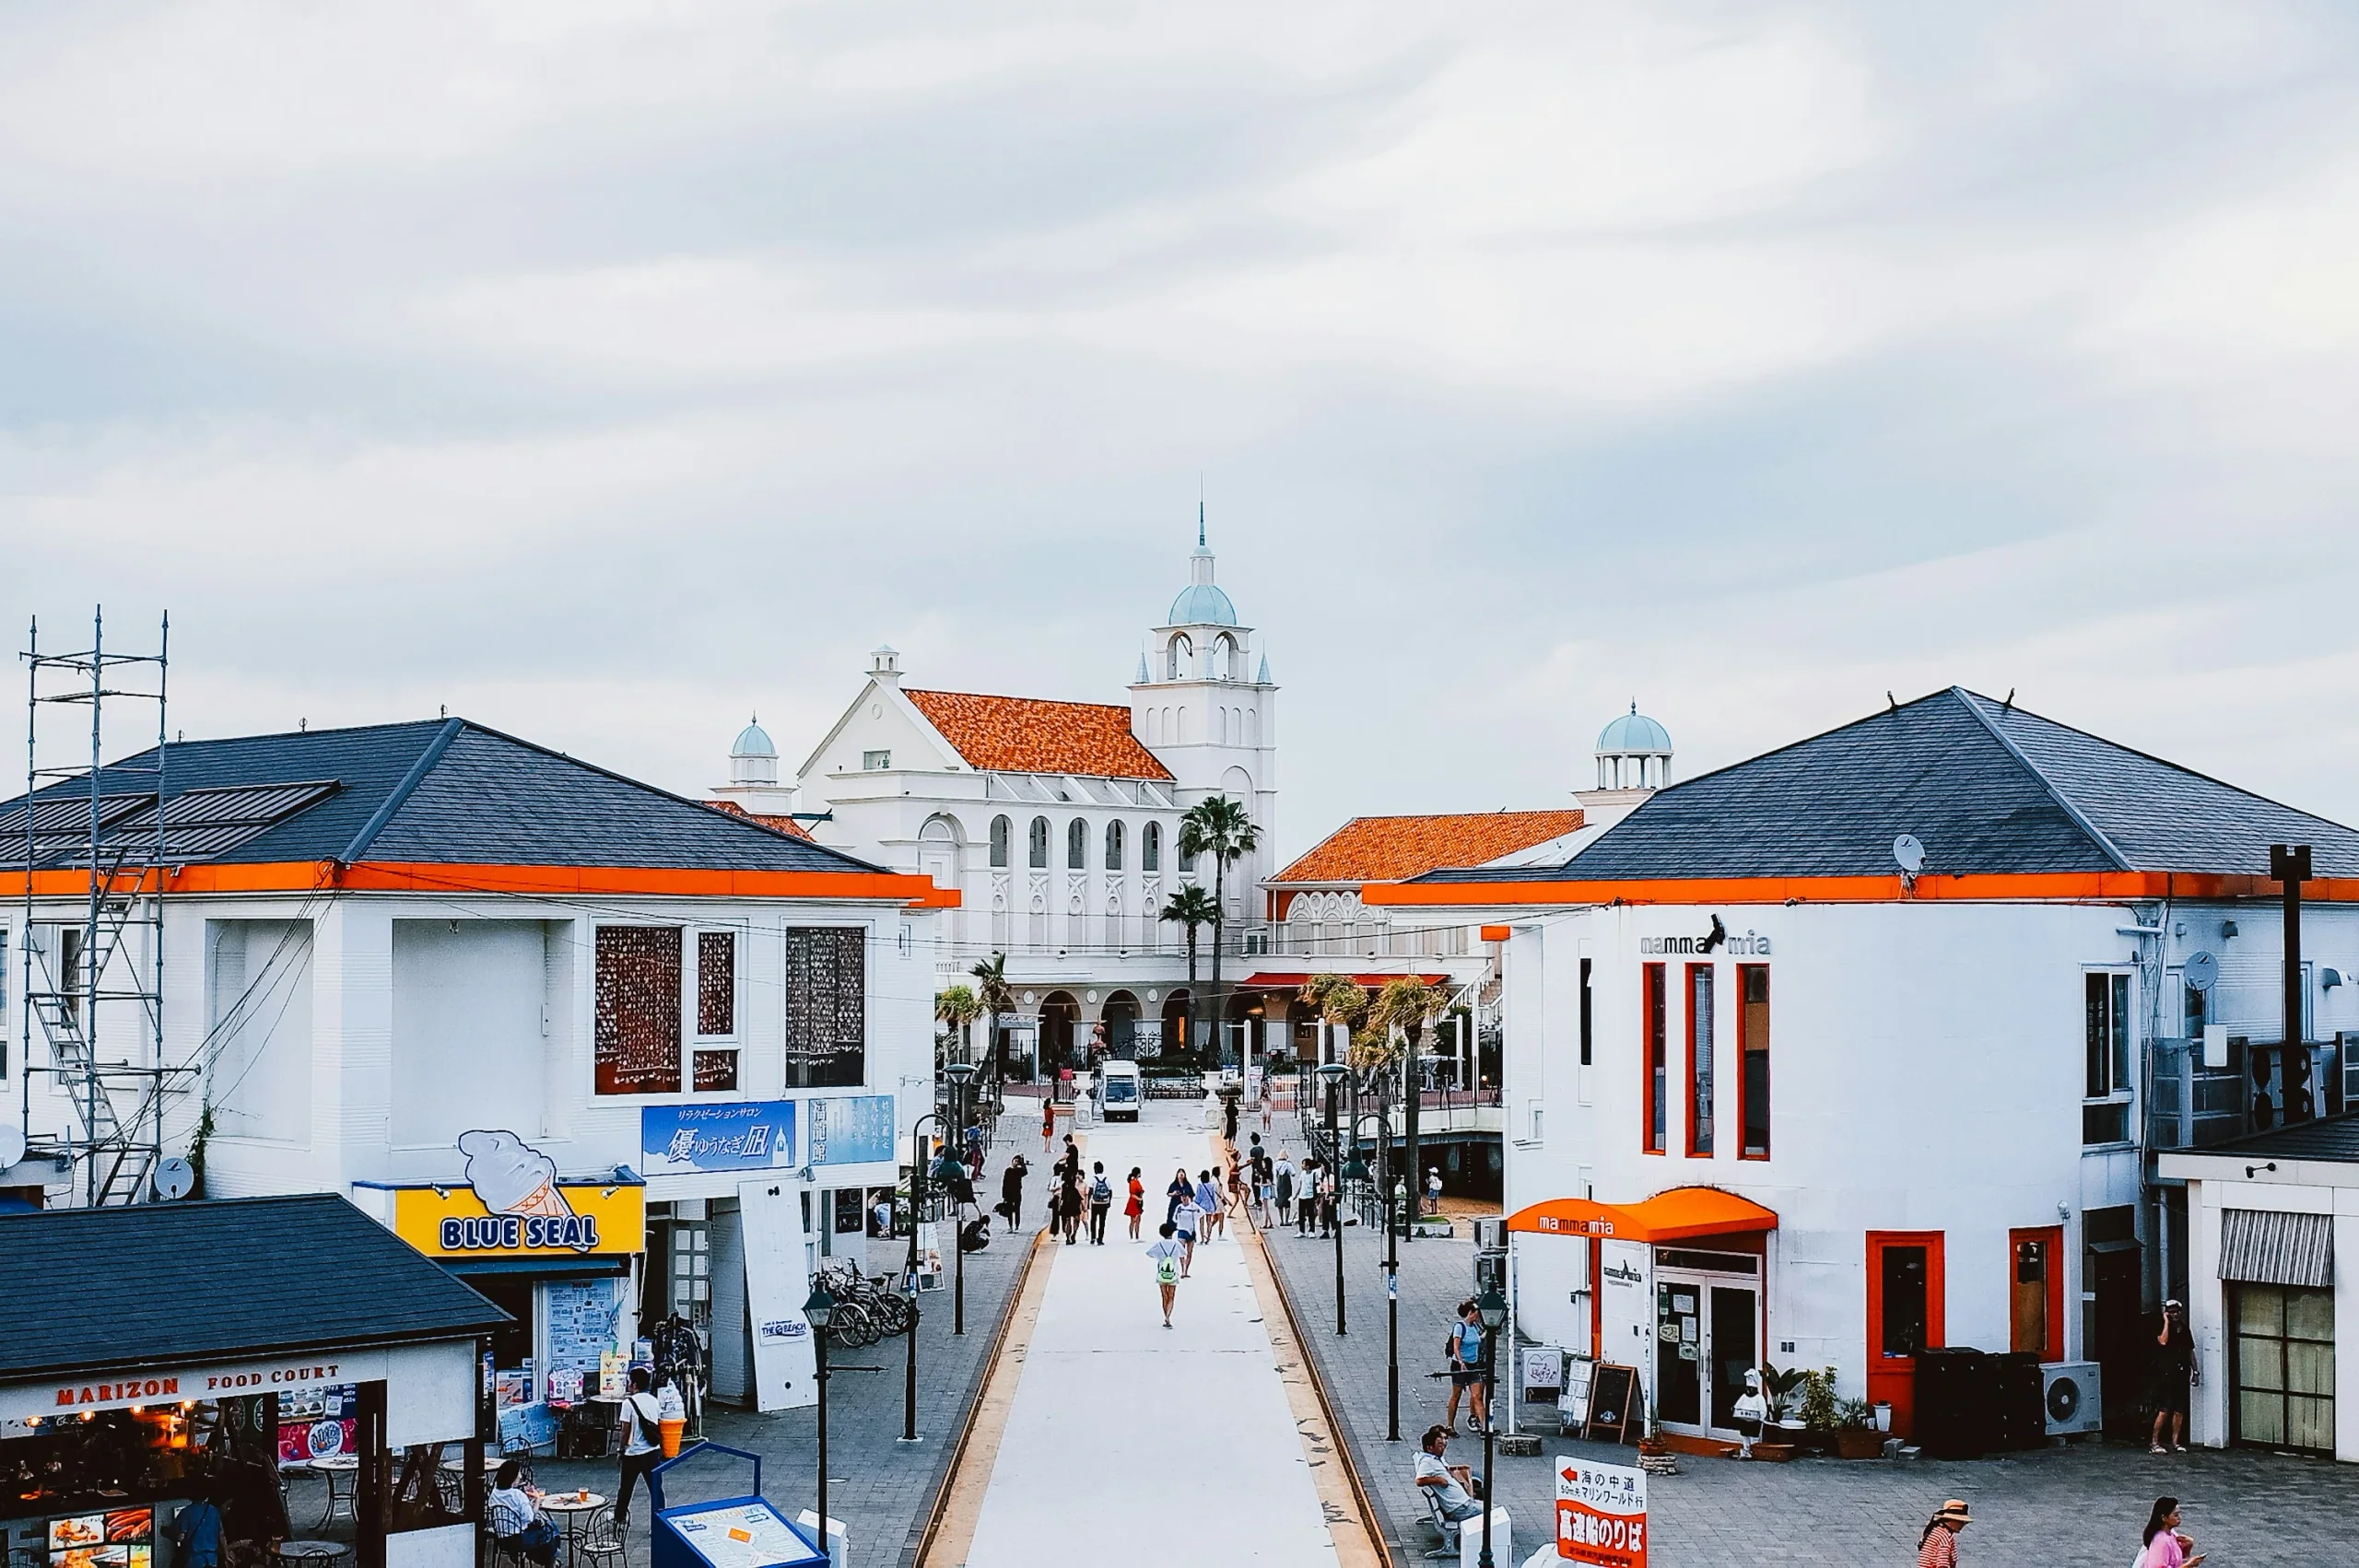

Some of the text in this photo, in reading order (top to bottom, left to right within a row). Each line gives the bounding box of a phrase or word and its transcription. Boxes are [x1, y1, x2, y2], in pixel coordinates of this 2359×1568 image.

[1728, 929, 1771, 955] mia
[678, 1107, 763, 1121] リラクゼーションサロン
[440, 1213, 600, 1251] BLUE SEAL
[56, 1364, 340, 1406] MARIZON FOOD COURT
[1581, 1469, 1635, 1492] 海の中道
[1559, 1508, 1643, 1553] 高速船のりば
